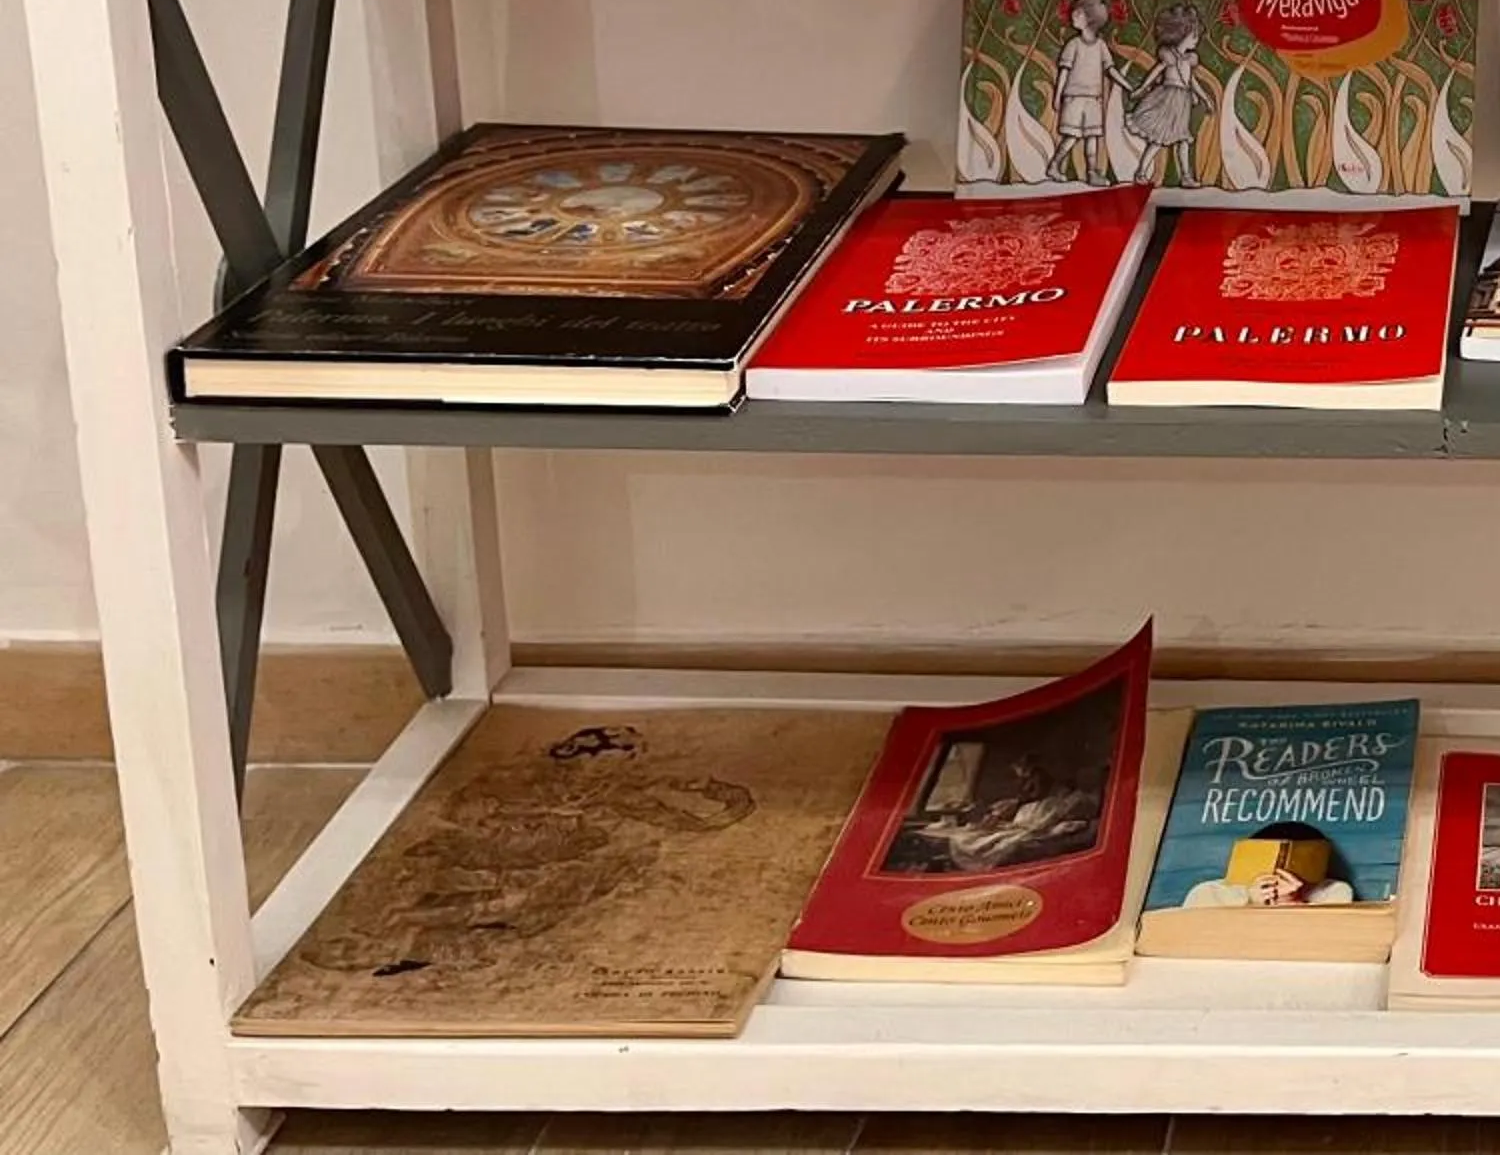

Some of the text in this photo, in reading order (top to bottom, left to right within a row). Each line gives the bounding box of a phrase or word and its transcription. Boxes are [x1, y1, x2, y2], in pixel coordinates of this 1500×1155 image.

[841, 287, 1068, 314] PALERMO
[1171, 323, 1407, 345] PALERMO
[1202, 732, 1406, 784] READERS
[1201, 786, 1386, 825] RECOMMEND
